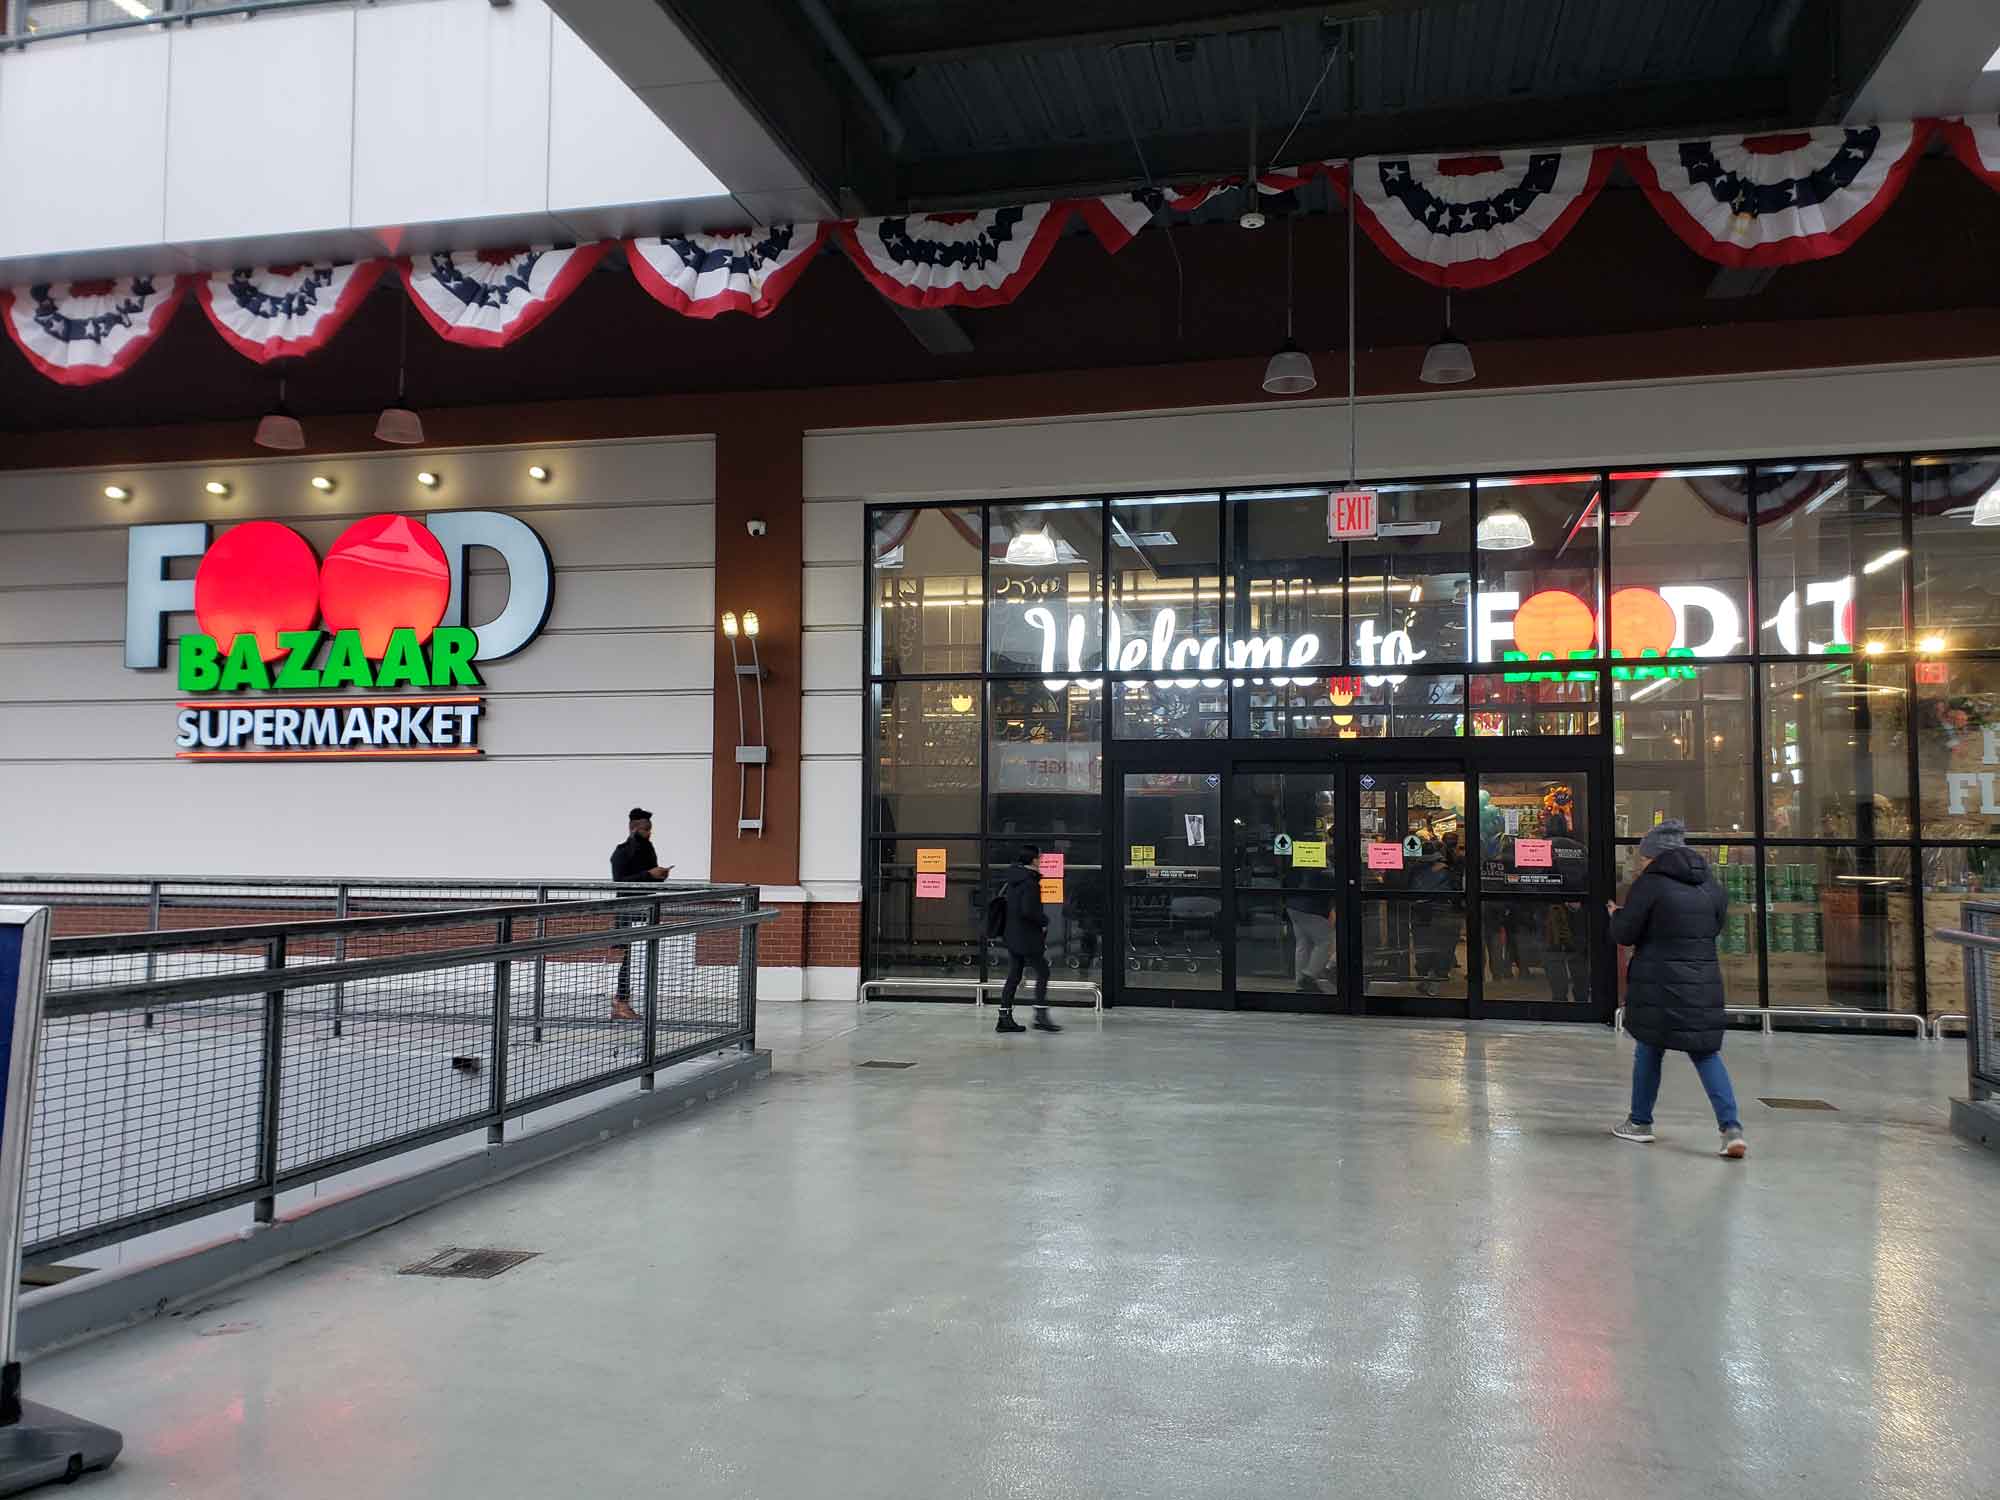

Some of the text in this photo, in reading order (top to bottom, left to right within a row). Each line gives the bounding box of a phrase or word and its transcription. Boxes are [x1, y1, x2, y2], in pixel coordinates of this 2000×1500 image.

[1336, 496, 1372, 531] EXIT
[124, 511, 553, 669] FOOD
[1467, 586, 1740, 663] FOOD
[177, 626, 484, 692] BAZAAR
[1024, 607, 1427, 690] Welcome to
[176, 705, 481, 748] SUPERMARKET
